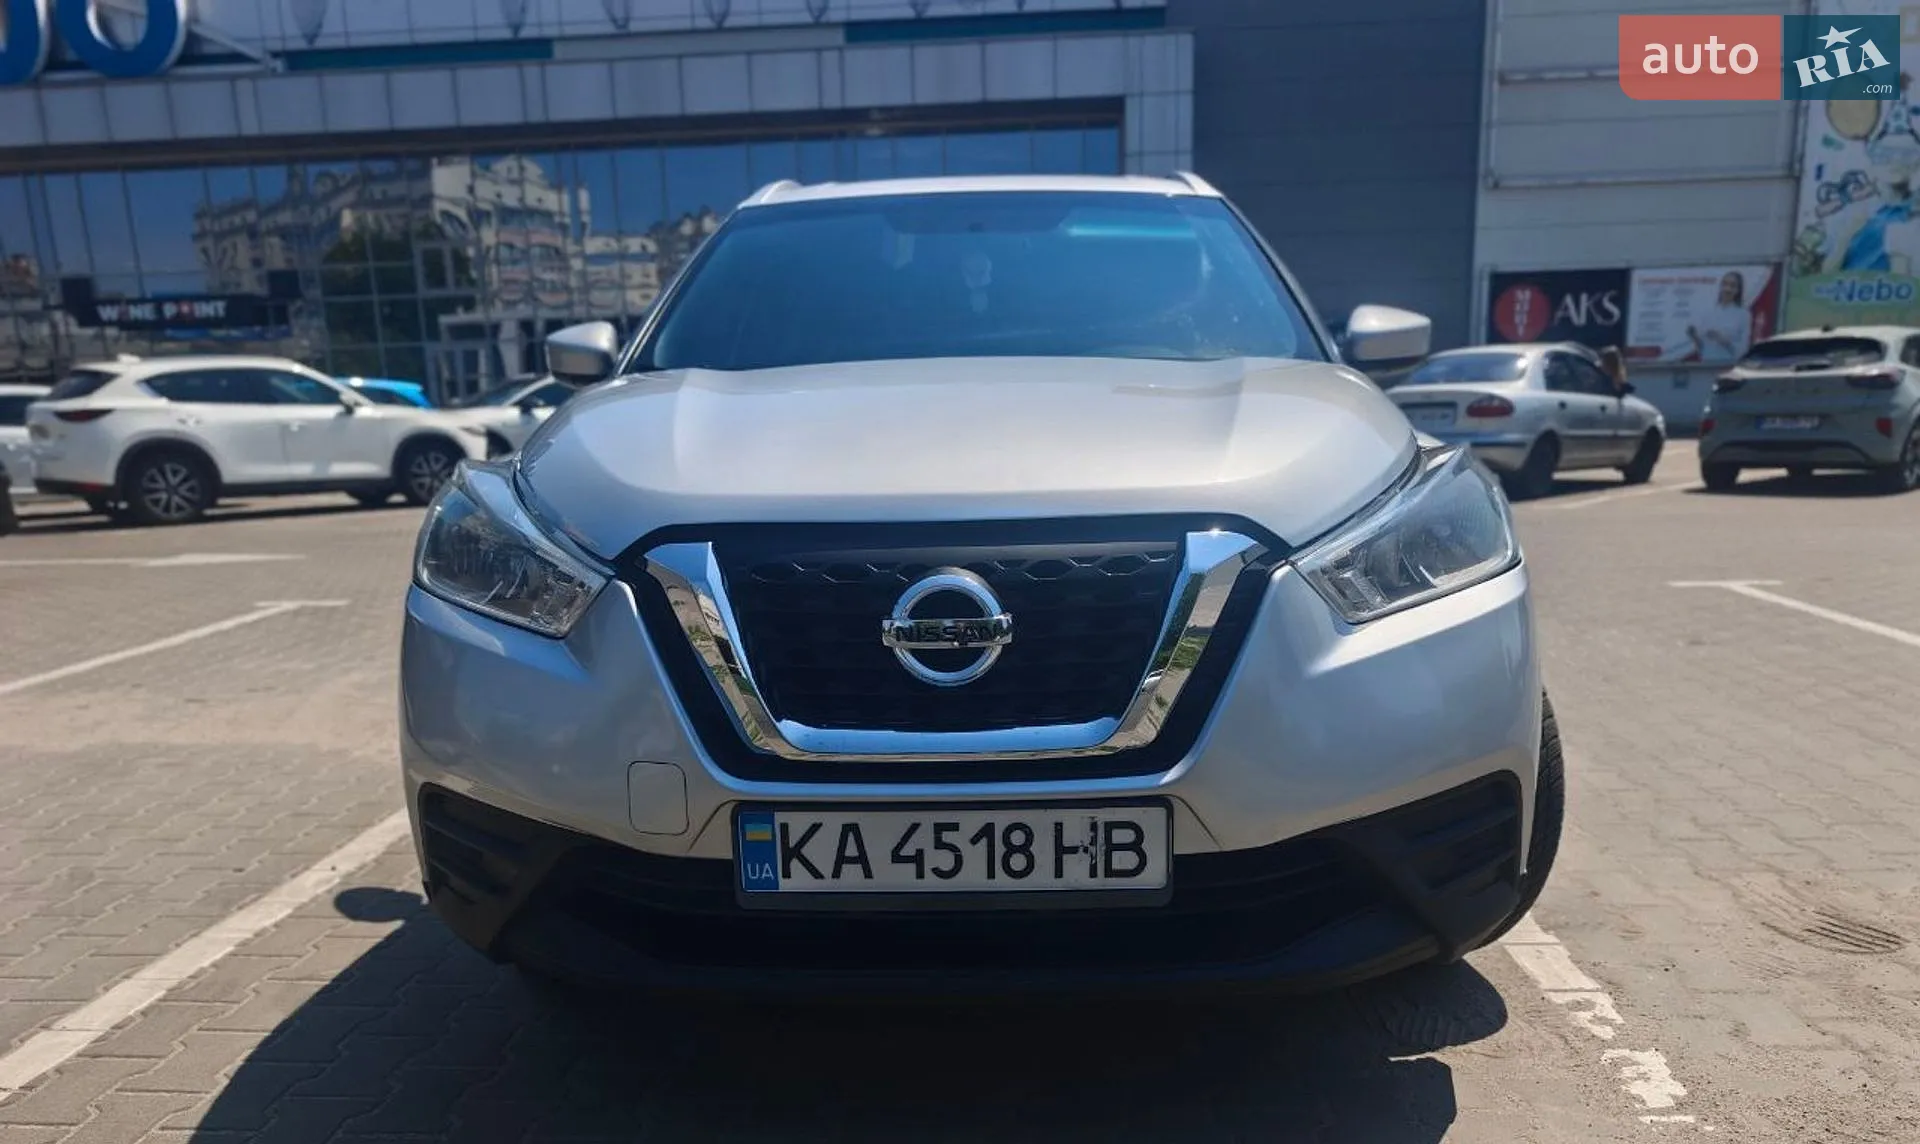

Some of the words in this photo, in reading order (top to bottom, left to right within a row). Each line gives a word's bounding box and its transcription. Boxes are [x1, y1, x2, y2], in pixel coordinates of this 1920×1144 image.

[1834, 277, 1912, 302] Nebo
[1554, 289, 1621, 326] AKS
[894, 623, 1003, 643] NISSAN
[779, 821, 874, 880] KA
[890, 821, 1036, 880] 4518
[1053, 819, 1148, 879] HB
[747, 862, 775, 881] UA
